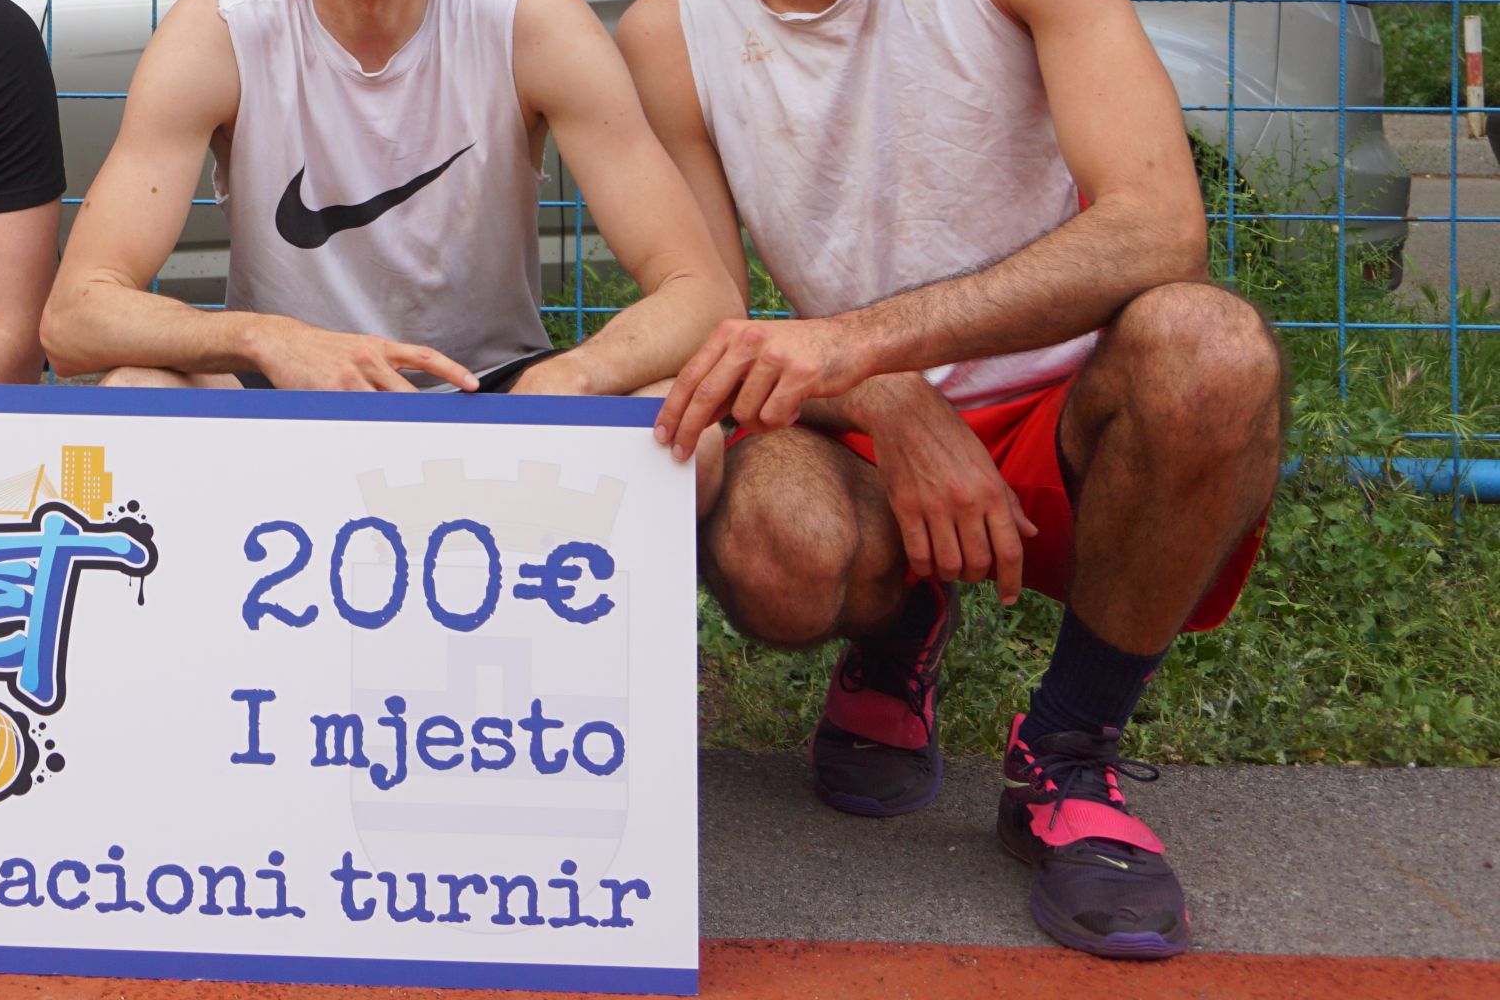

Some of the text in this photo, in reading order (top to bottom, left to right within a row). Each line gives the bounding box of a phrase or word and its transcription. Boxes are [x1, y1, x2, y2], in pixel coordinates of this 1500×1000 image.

[242, 516, 614, 632] 200€
[231, 689, 625, 790] I mjesto
[330, 851, 650, 928] turnir
